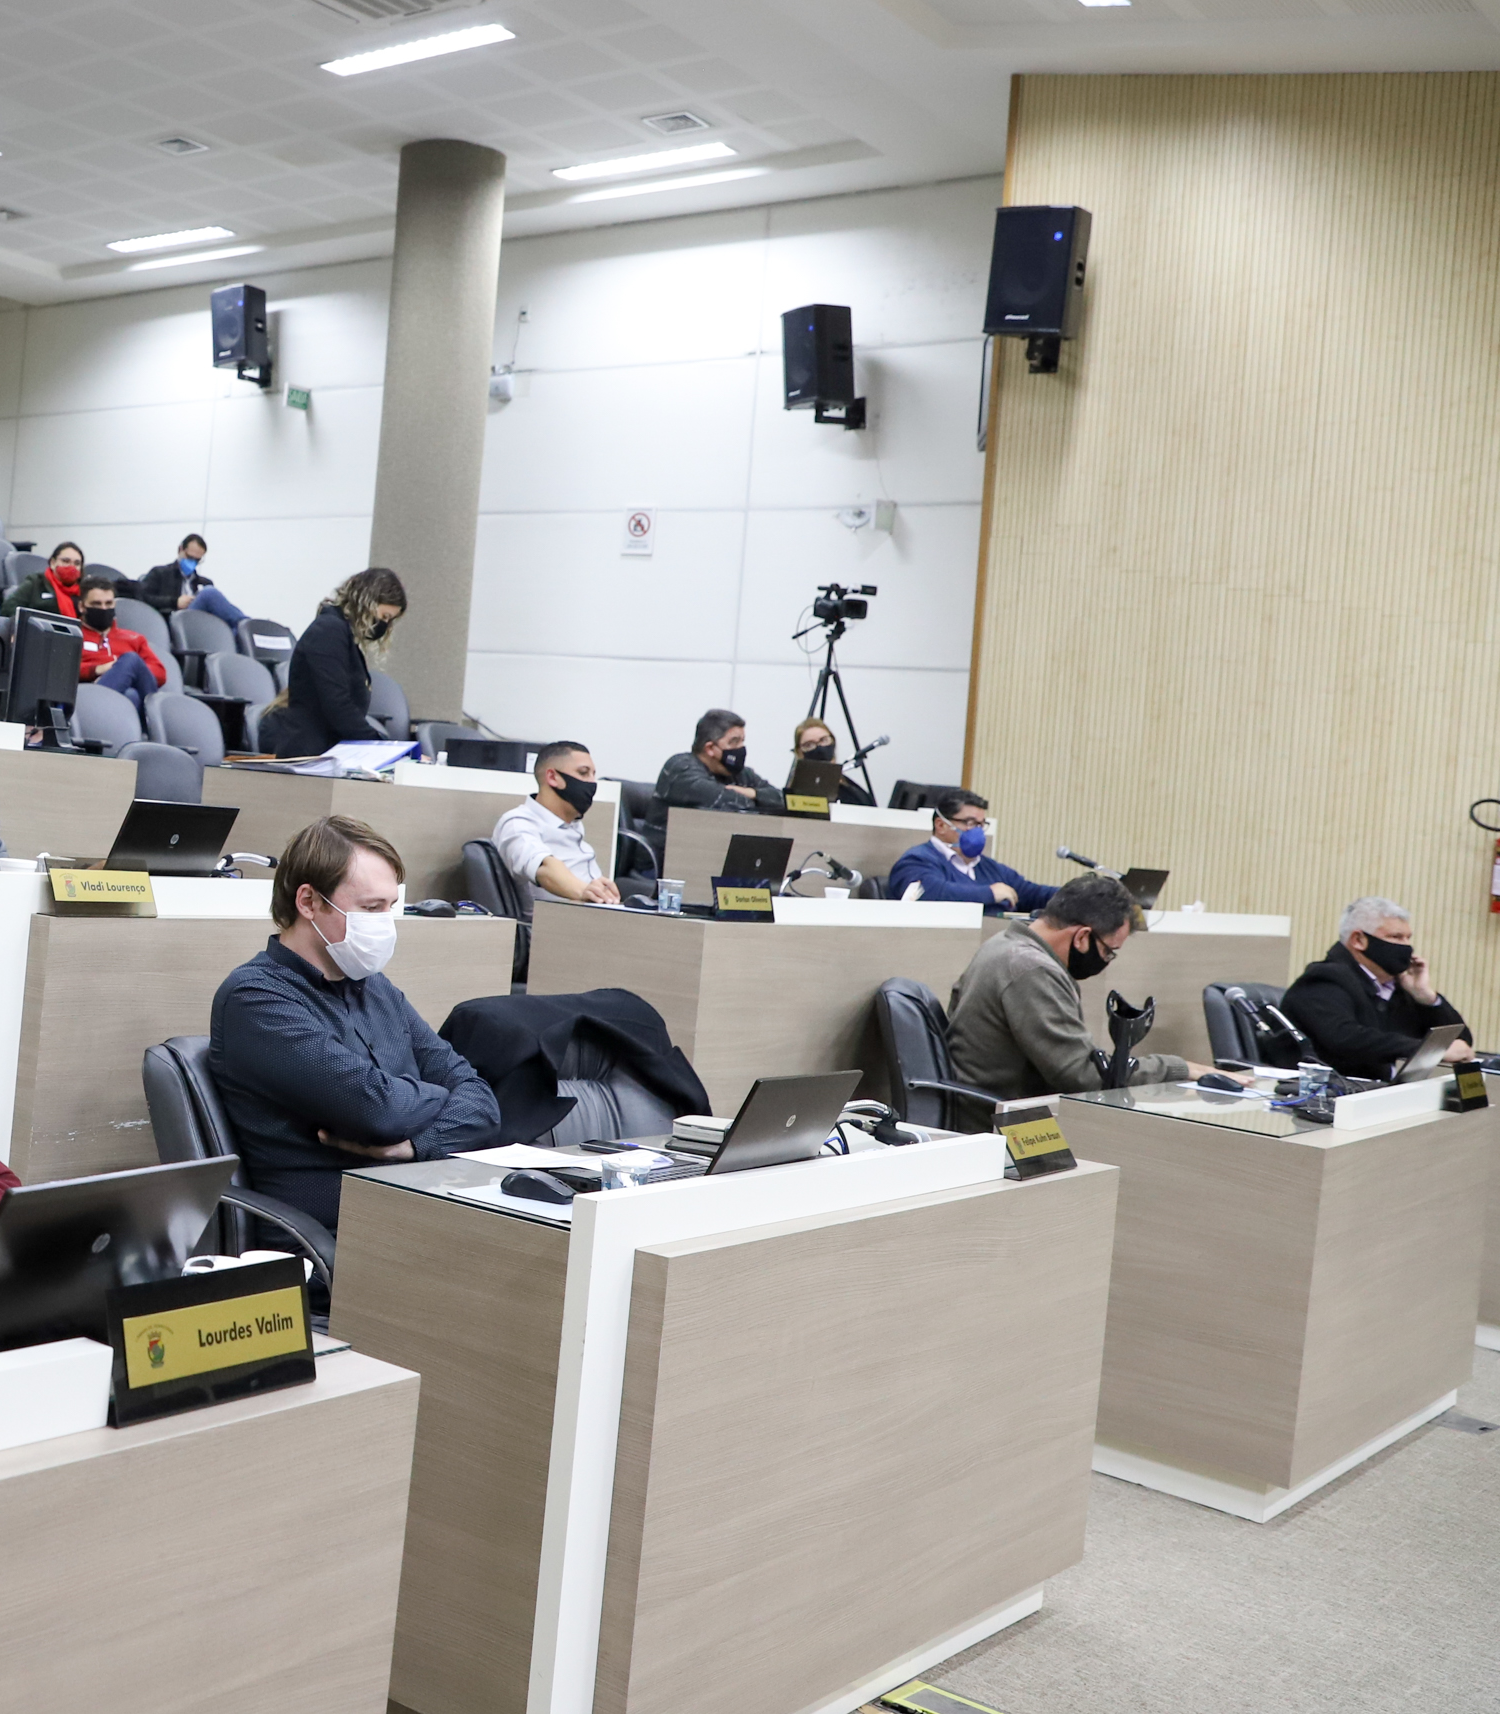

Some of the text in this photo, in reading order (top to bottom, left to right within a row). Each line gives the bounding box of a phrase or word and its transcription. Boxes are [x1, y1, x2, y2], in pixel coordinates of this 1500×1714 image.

[81, 881, 146, 895] Vladi Lourenço
[198, 1321, 253, 1348] Lourdes
[255, 1313, 294, 1335] Valim
